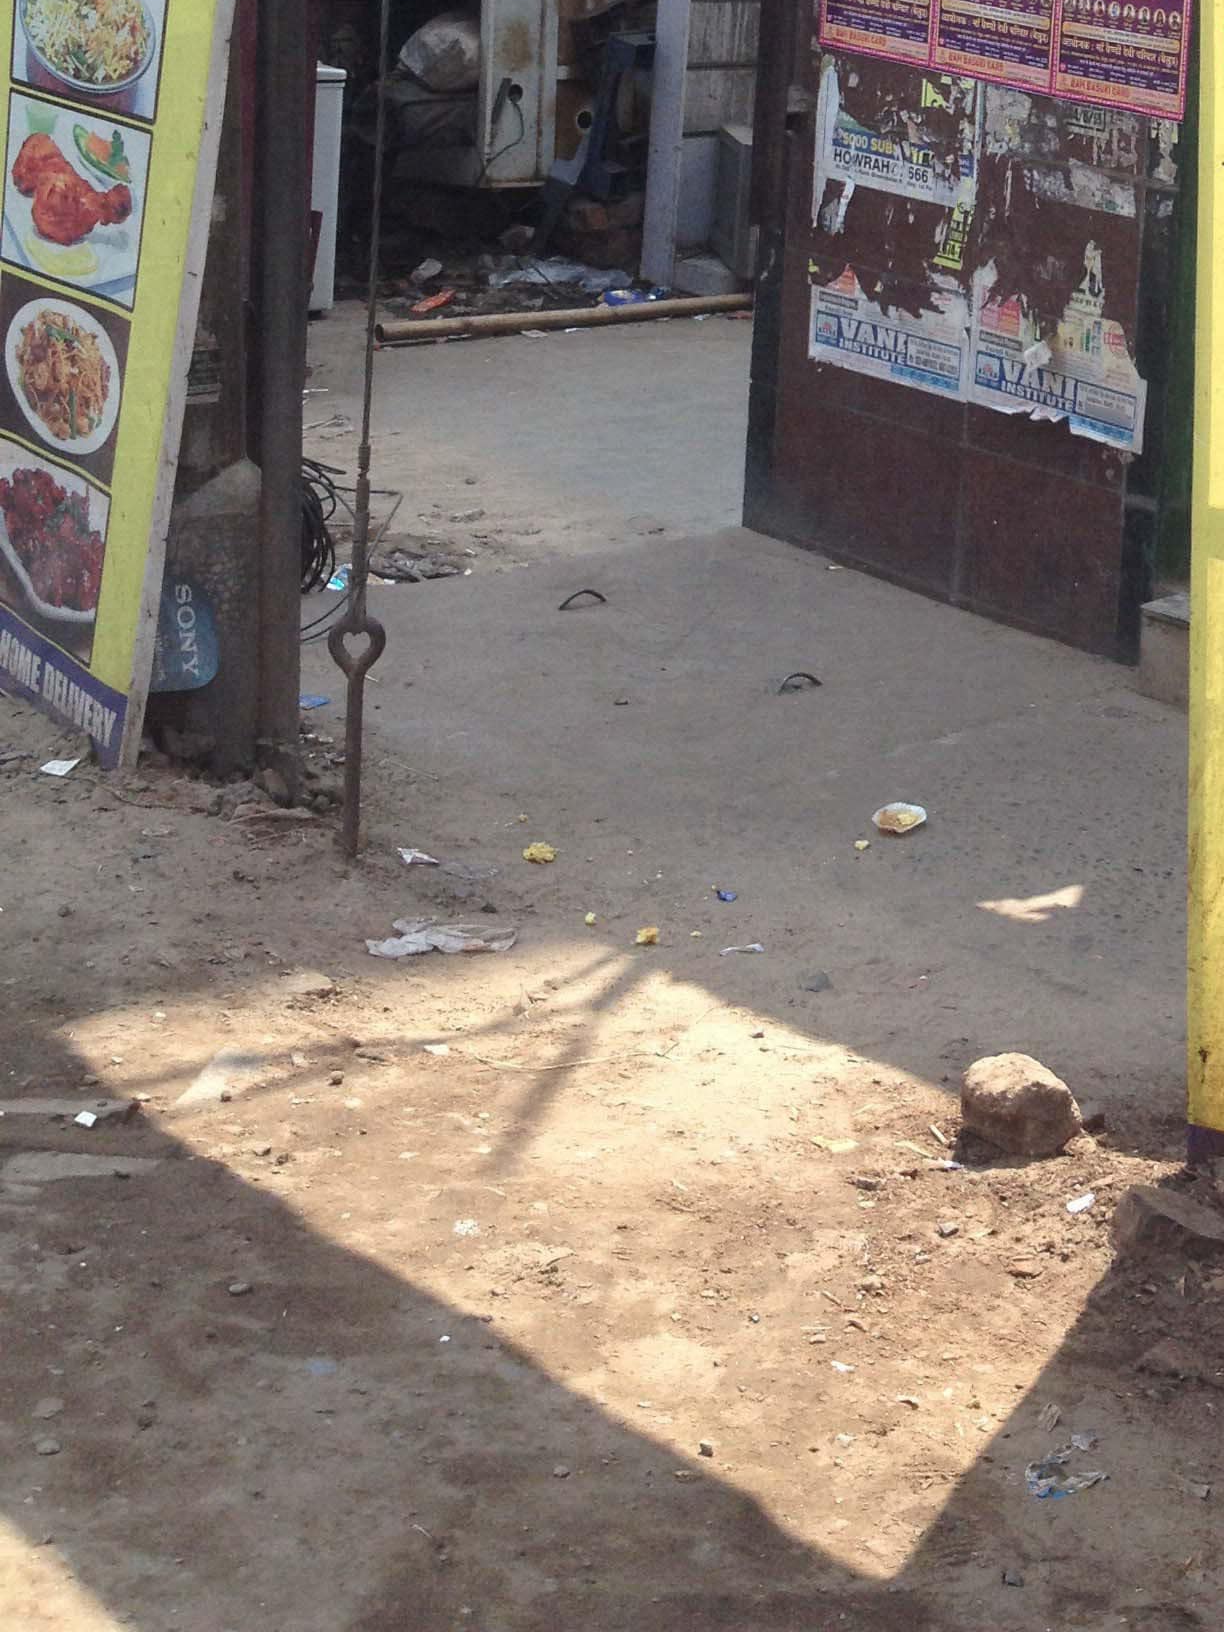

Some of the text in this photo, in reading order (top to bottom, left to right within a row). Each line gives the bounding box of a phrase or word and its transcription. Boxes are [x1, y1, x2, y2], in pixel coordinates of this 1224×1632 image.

[839, 317, 908, 354] VANI
[839, 337, 907, 365] INSTITUTE
[1000, 380, 1075, 413] INSTITUTE
[174, 583, 200, 677] SONY
[0, 628, 117, 749] HOME DELIVERY
